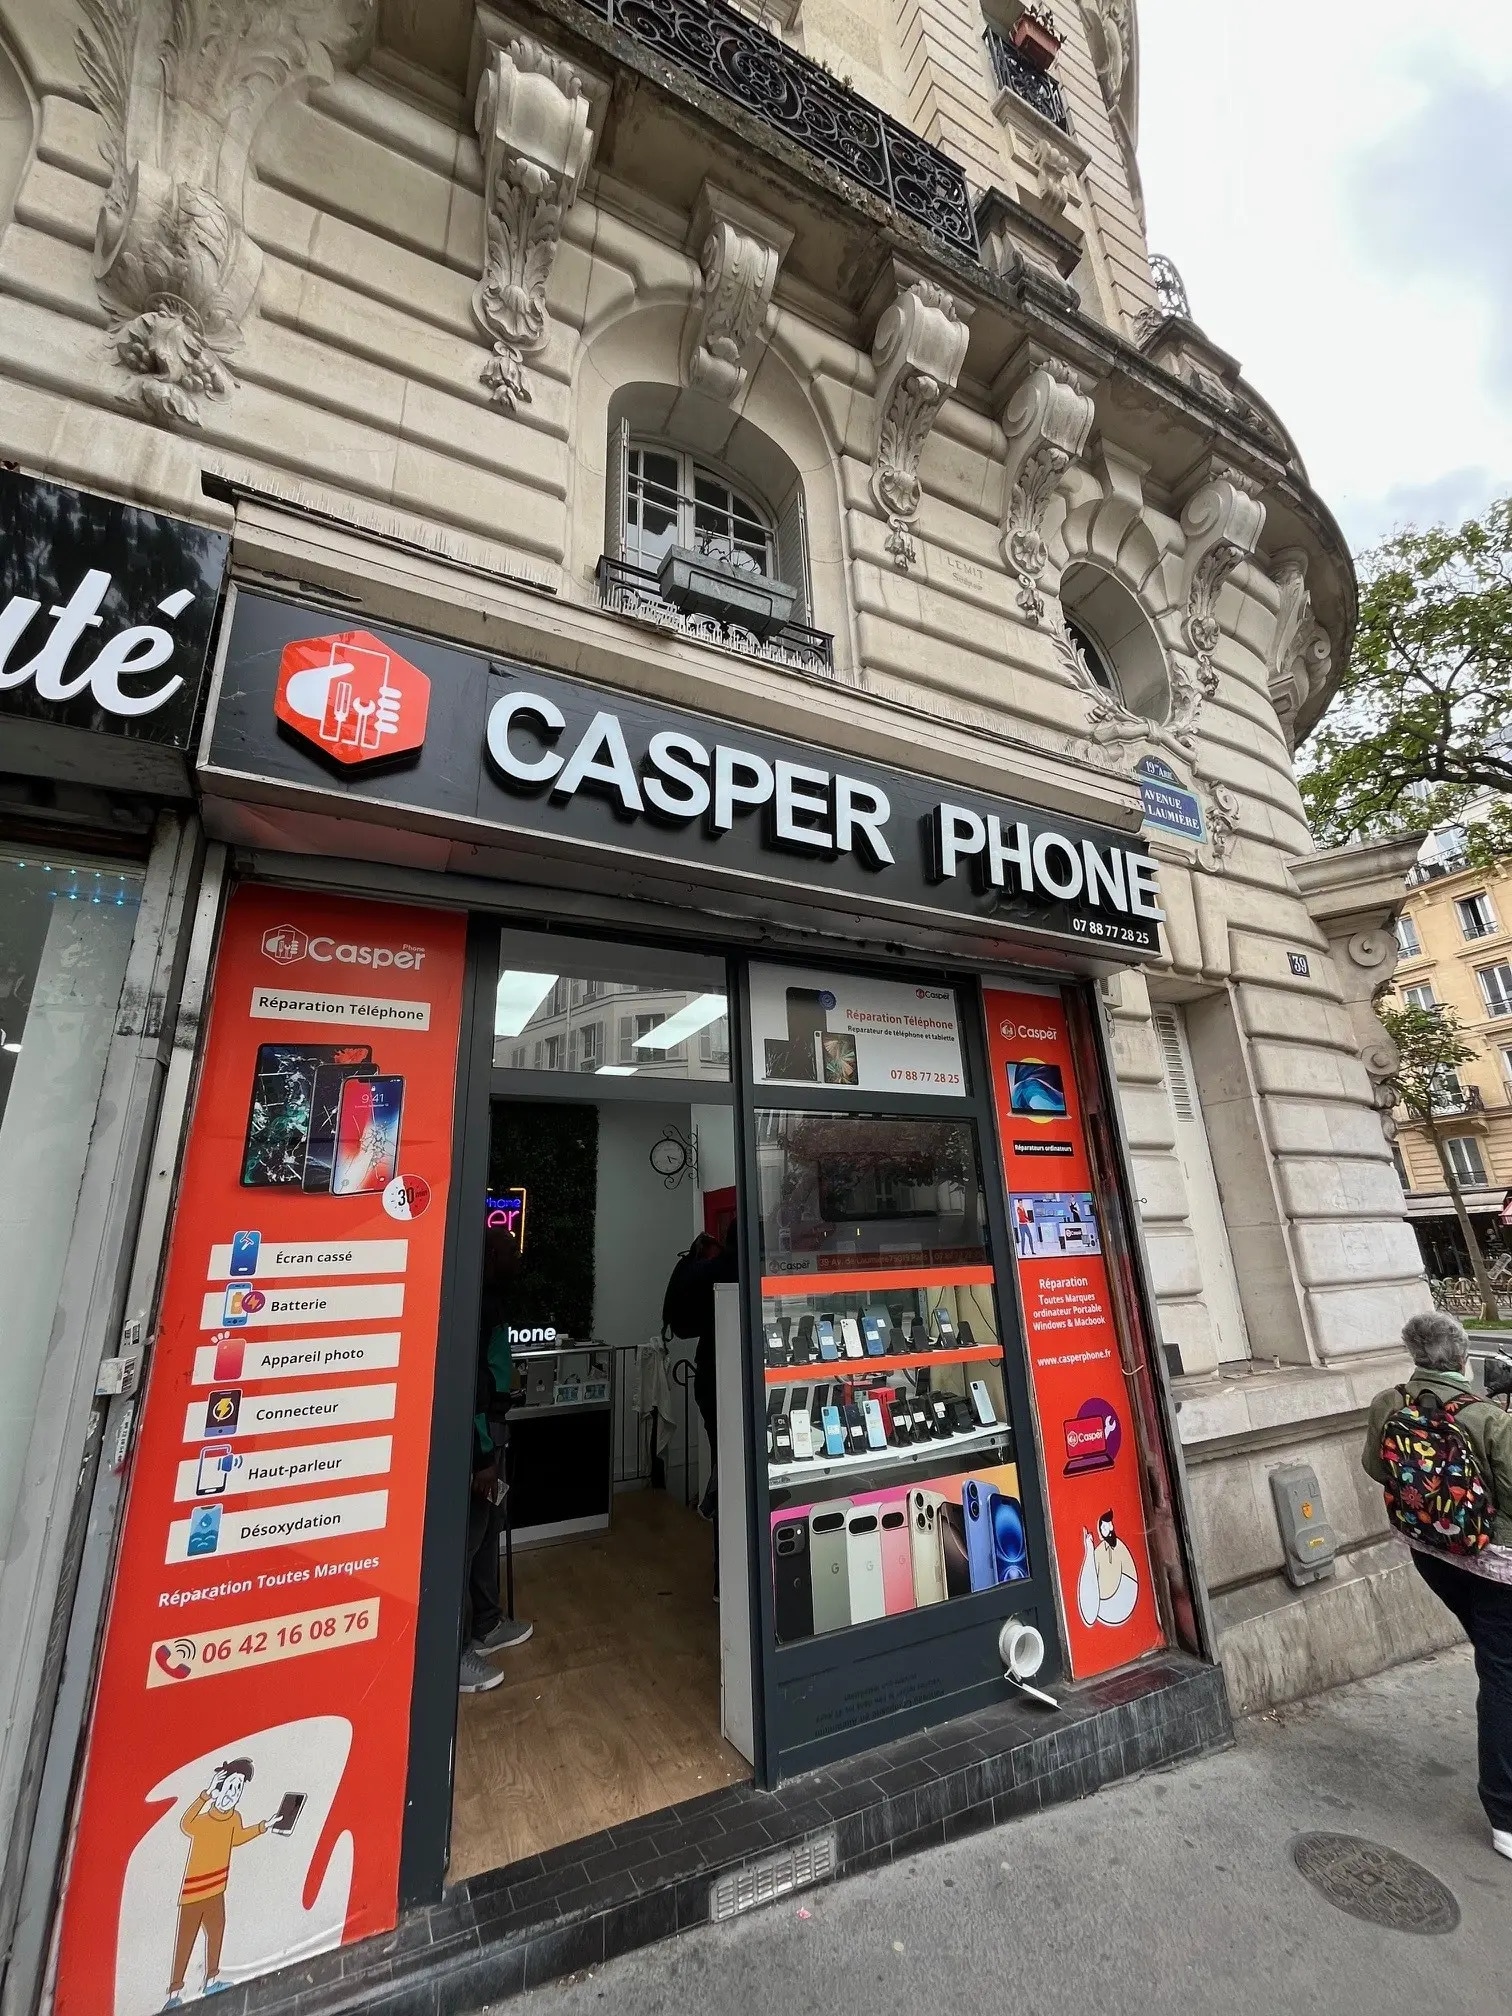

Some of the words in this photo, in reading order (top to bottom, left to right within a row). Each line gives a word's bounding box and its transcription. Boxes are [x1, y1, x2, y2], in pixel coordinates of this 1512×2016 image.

[486, 691, 896, 865] CASPER
[940, 802, 1167, 923] PHONE
[1144, 789, 1183, 810] AVENUE
[1147, 804, 1200, 830] LAUMIÈRE
[1072, 918, 1086, 932] 07
[1089, 922, 1104, 936] 88
[1105, 924, 1118, 938] 77
[1120, 928, 1135, 942] 28
[1136, 932, 1150, 944] 25
[307, 936, 426, 972] Casper
[402, 943, 426, 953] Phone
[1292, 955, 1308, 974] 39
[258, 995, 345, 1015] Réparation
[348, 1003, 425, 1023] Téléphone
[846, 1008, 902, 1025] Réparation
[903, 1014, 954, 1030] Téléphone
[884, 1028, 892, 1036] de
[924, 1032, 932, 1040] et
[1018, 1025, 1057, 1041] Casper
[890, 1069, 902, 1080] 07
[905, 1070, 918, 1081] 88
[920, 1071, 932, 1082] 77
[934, 1072, 946, 1083] 28
[948, 1073, 960, 1084] 25
[398, 1186, 415, 1206] 30
[486, 1198, 522, 1208] hone
[275, 1250, 314, 1265] Écran
[316, 1250, 353, 1264] cassé
[779, 1260, 810, 1272] Casper
[1038, 1276, 1088, 1292] Réparation
[270, 1298, 328, 1313] Batterie
[1038, 1294, 1064, 1306] Toutes
[1065, 1292, 1096, 1304] Marques
[1032, 1308, 1072, 1319] ordinateur
[1072, 1304, 1102, 1316] Portable
[1032, 1319, 1066, 1331] Windows
[1066, 1319, 1074, 1328] &
[1074, 1315, 1106, 1327] Macbook
[260, 1350, 321, 1369] Appareil
[324, 1349, 365, 1364] photo
[1037, 1349, 1112, 1367] www.casperphone.fr
[255, 1402, 340, 1421] Connecteur
[1078, 1429, 1103, 1444] Casper
[247, 1458, 343, 1480] Haut-parleur
[239, 1513, 342, 1540] Désoxydation
[157, 1580, 253, 1608] Réparation
[256, 1569, 311, 1589] Toutes
[313, 1555, 380, 1580] Marques
[201, 1638, 233, 1664] 06
[238, 1631, 269, 1656] 42
[276, 1623, 304, 1648] 16
[308, 1616, 337, 1641] 08
[342, 1608, 370, 1633] 76
